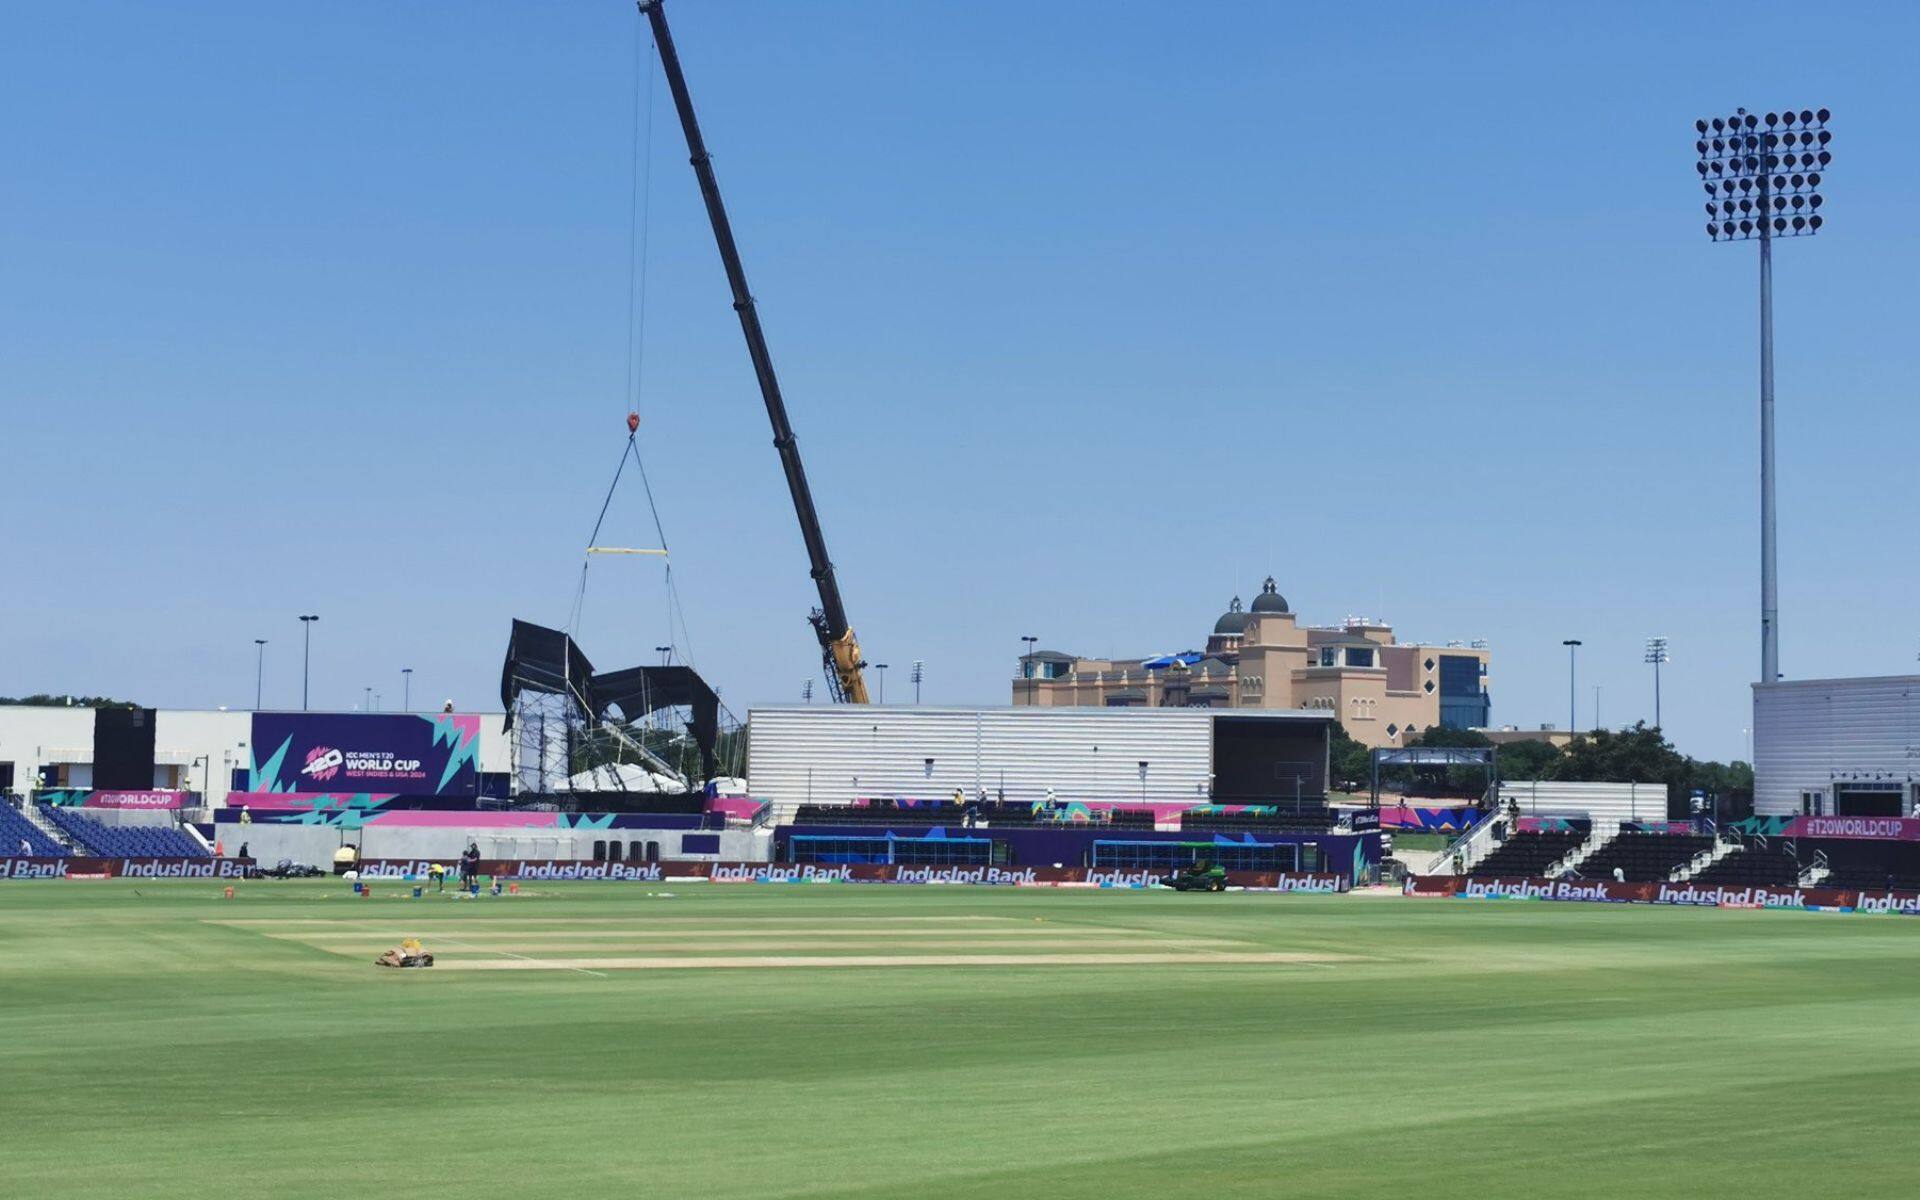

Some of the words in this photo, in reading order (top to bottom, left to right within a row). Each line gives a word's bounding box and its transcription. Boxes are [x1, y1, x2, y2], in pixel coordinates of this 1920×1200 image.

[359, 752, 381, 760] MEN'S
[382, 752, 394, 760] T20
[345, 760, 392, 771] WORLD
[394, 760, 421, 772] CUP
[1807, 819, 1902, 836] #T20WORLDCUP
[15, 860, 69, 877] Bank
[122, 860, 216, 877] IndusInd
[518, 861, 608, 877] IndusInd
[611, 862, 661, 878] Bank
[711, 863, 800, 879] IndusInd
[803, 864, 852, 881] Bank
[896, 865, 984, 882] IndusInd
[987, 867, 1037, 883] Bank
[1465, 878, 1555, 896] IndusInd
[1557, 882, 1608, 899] Bank
[1658, 884, 1751, 904] IndusInd
[1754, 888, 1805, 907] Bank
